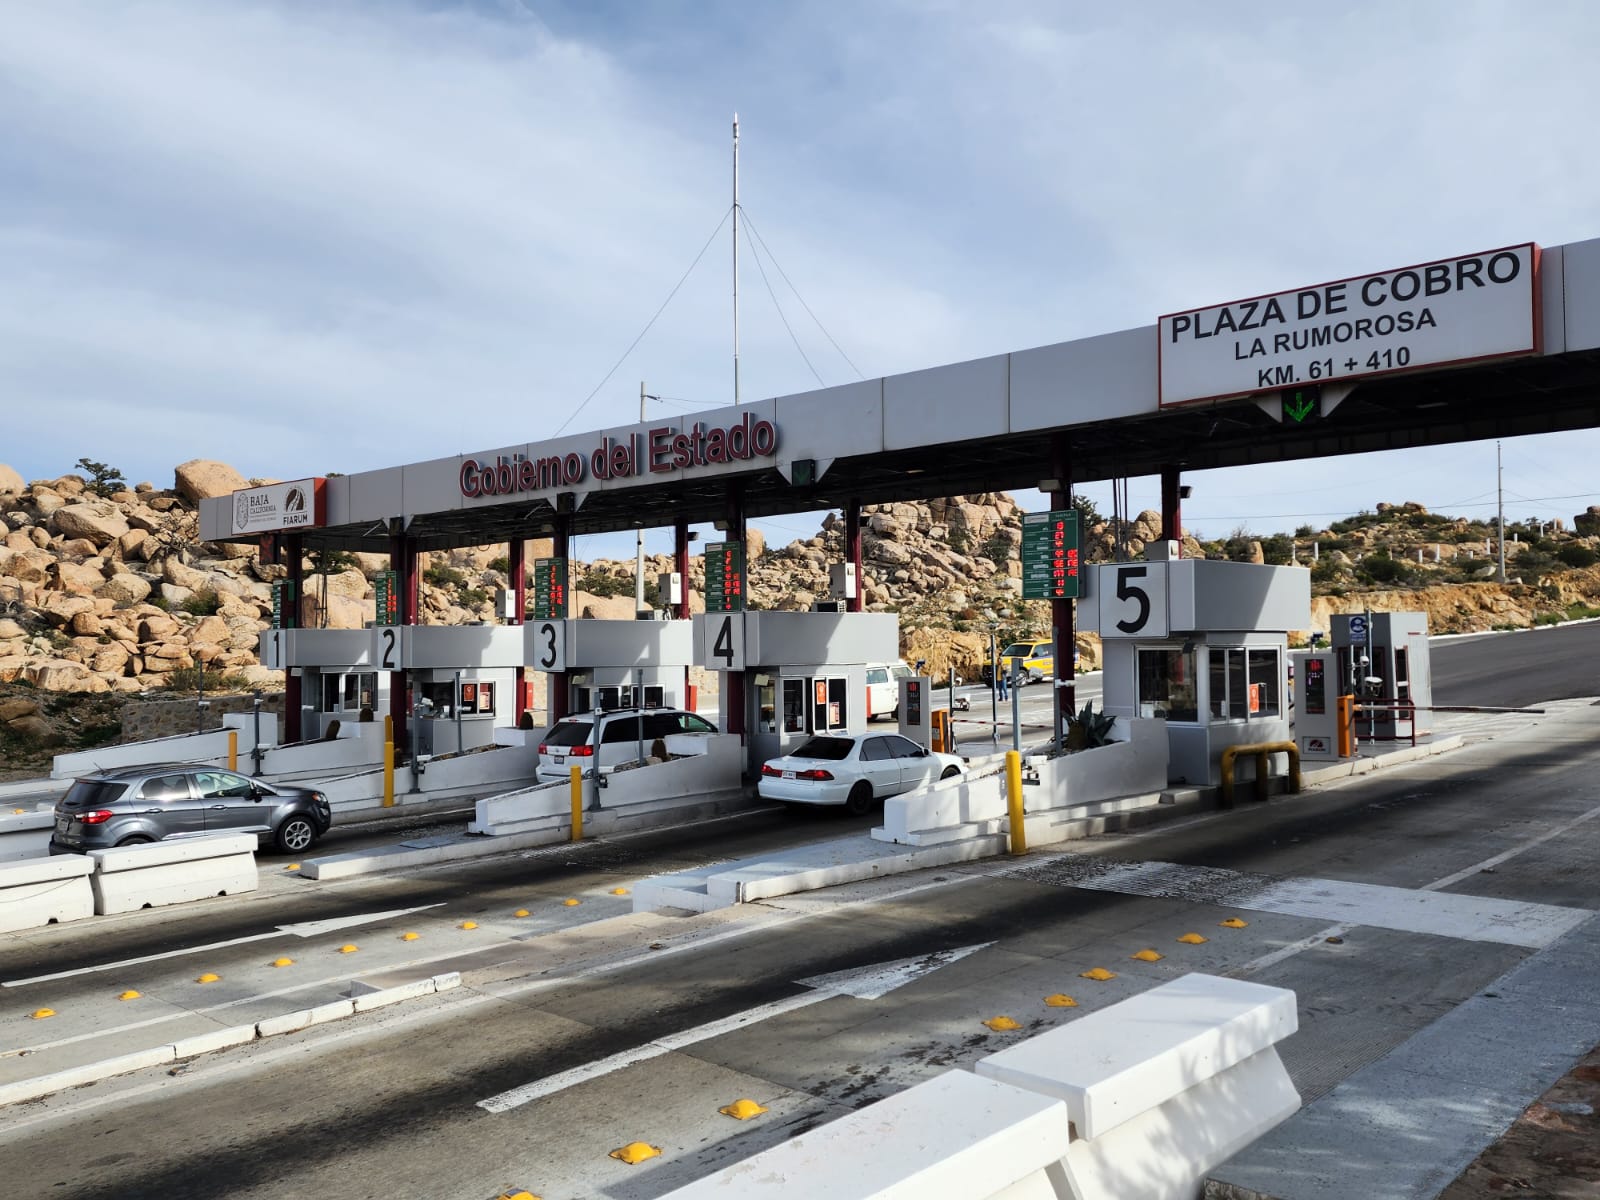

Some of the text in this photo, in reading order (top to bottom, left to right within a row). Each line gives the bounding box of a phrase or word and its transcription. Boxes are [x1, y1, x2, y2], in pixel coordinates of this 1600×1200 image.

[1171, 251, 1521, 343] PLAZA DE COBRO
[1235, 308, 1437, 361] LA RUMOROSA
[1258, 364, 1301, 387] KM.
[1308, 360, 1333, 380] 61
[1366, 346, 1411, 370] 410
[459, 411, 778, 498] Gobierno del Estado
[250, 494, 269, 507] BAJA
[283, 514, 308, 526] FIARUM
[1115, 566, 1151, 634] 5
[273, 631, 280, 668] 1
[382, 629, 396, 669] 2
[540, 623, 558, 668] 3
[713, 615, 734, 667] 4
